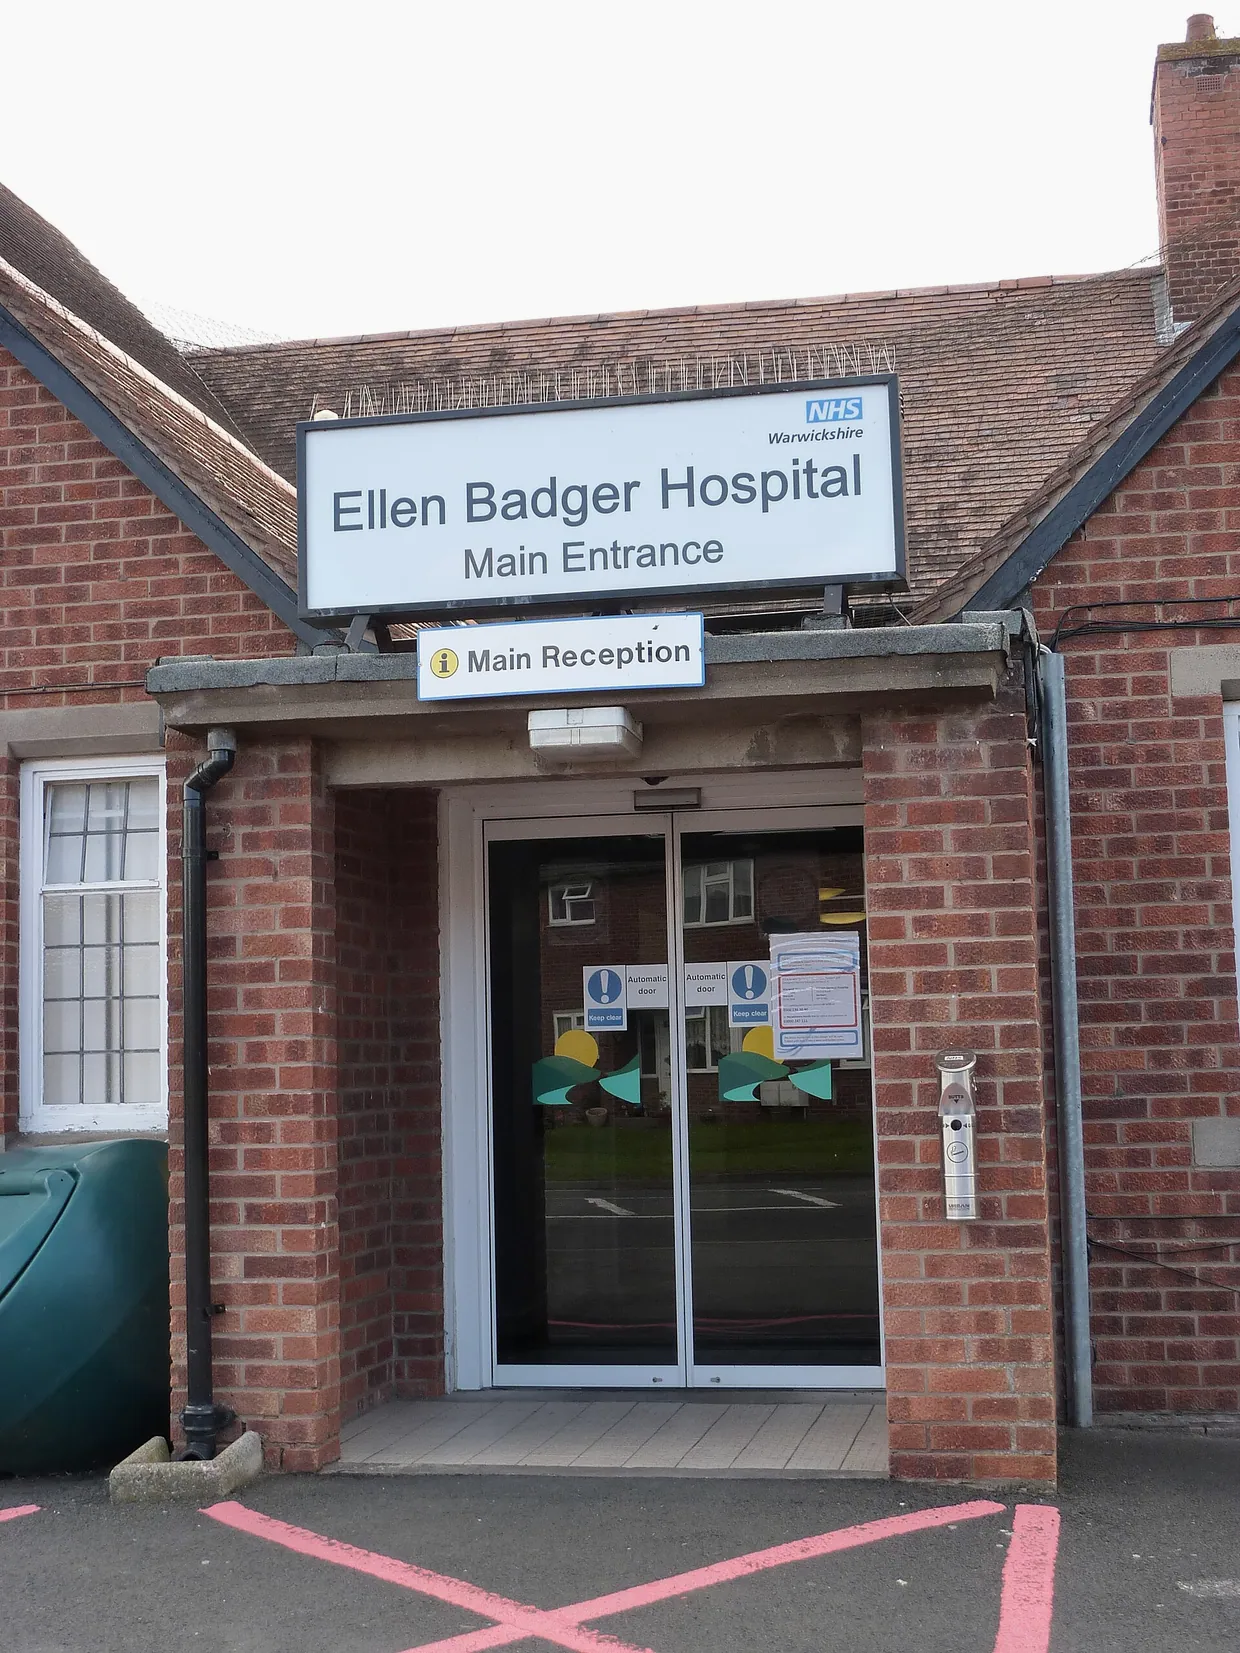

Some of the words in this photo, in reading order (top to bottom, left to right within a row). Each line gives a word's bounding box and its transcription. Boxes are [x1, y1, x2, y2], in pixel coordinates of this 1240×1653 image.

[807, 398, 861, 422] NHS
[768, 426, 864, 444] Warwickshire
[333, 488, 446, 532] Ellen
[466, 476, 641, 527] Badger
[660, 453, 862, 514] Hospital
[464, 545, 548, 580] Main
[562, 539, 724, 573] Entrance
[467, 646, 532, 673] Main
[541, 640, 690, 671] Reception
[627, 975, 667, 983] Automatic
[685, 973, 726, 981] Automatic
[637, 987, 657, 995] door
[697, 985, 716, 993] door
[588, 1014, 605, 1022] Keep
[733, 1010, 750, 1018] Keep
